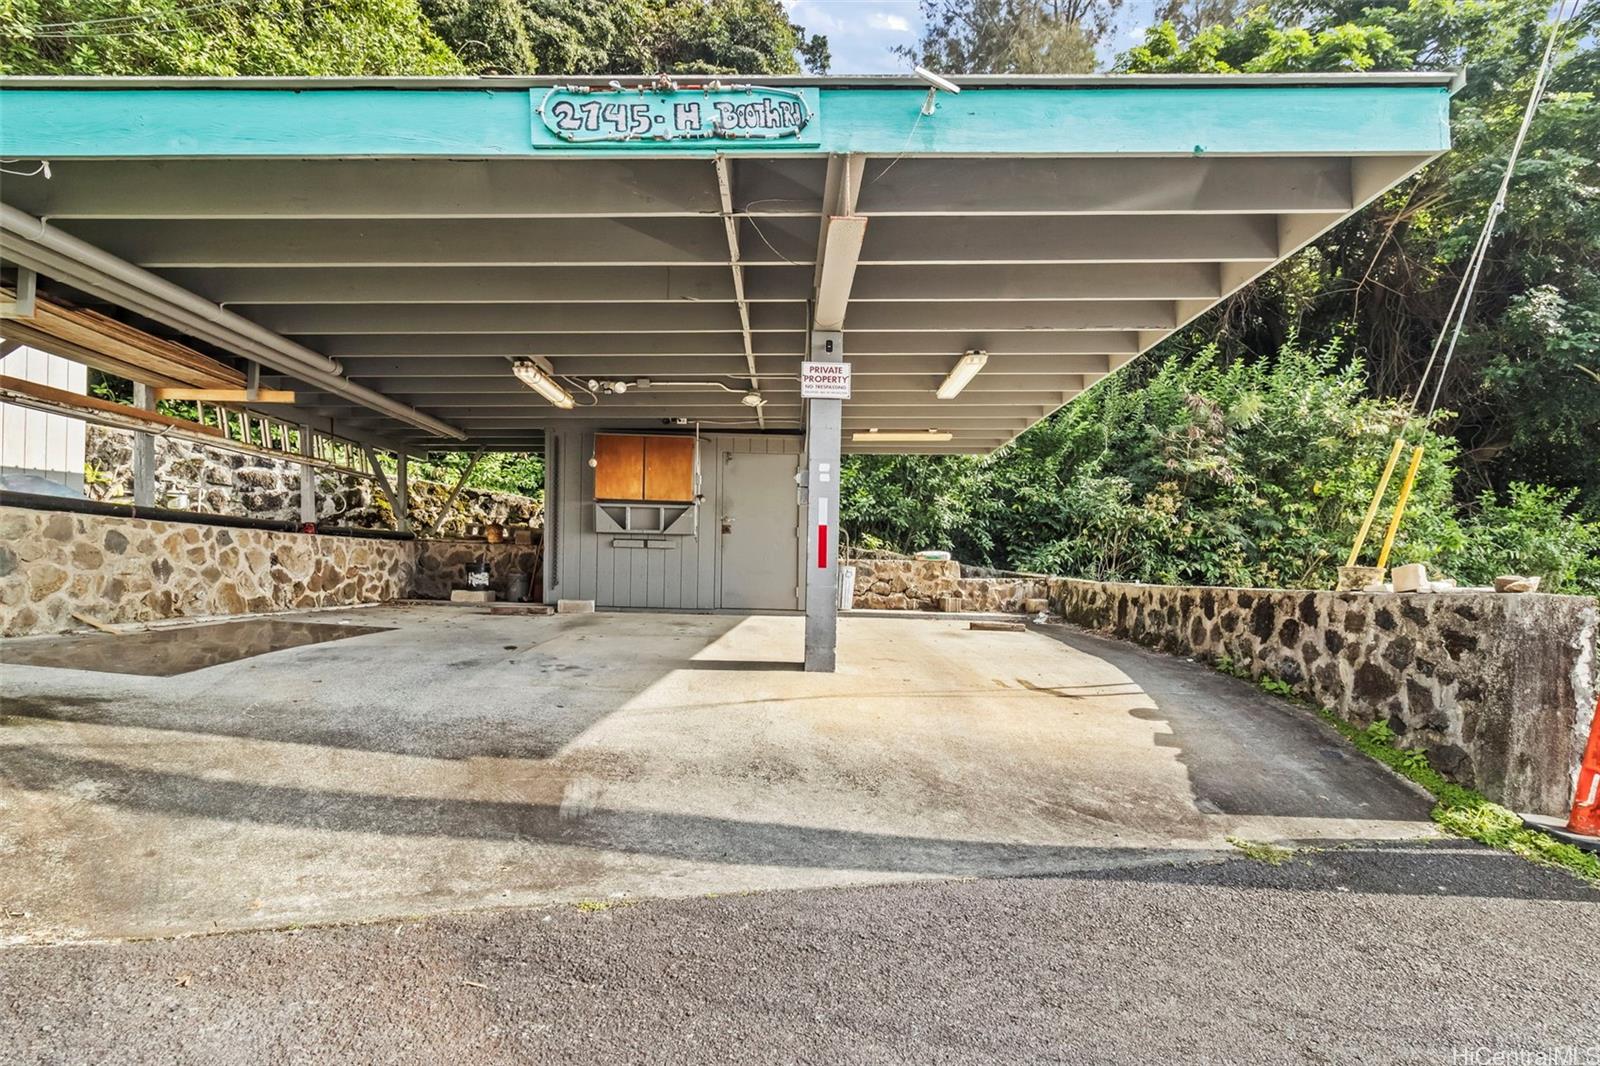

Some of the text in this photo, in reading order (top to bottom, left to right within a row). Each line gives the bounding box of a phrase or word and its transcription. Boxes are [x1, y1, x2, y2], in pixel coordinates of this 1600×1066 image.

[779, 101, 804, 128] Rd
[809, 366, 843, 374] PRIVATE
[803, 375, 849, 383] PROPERTY
